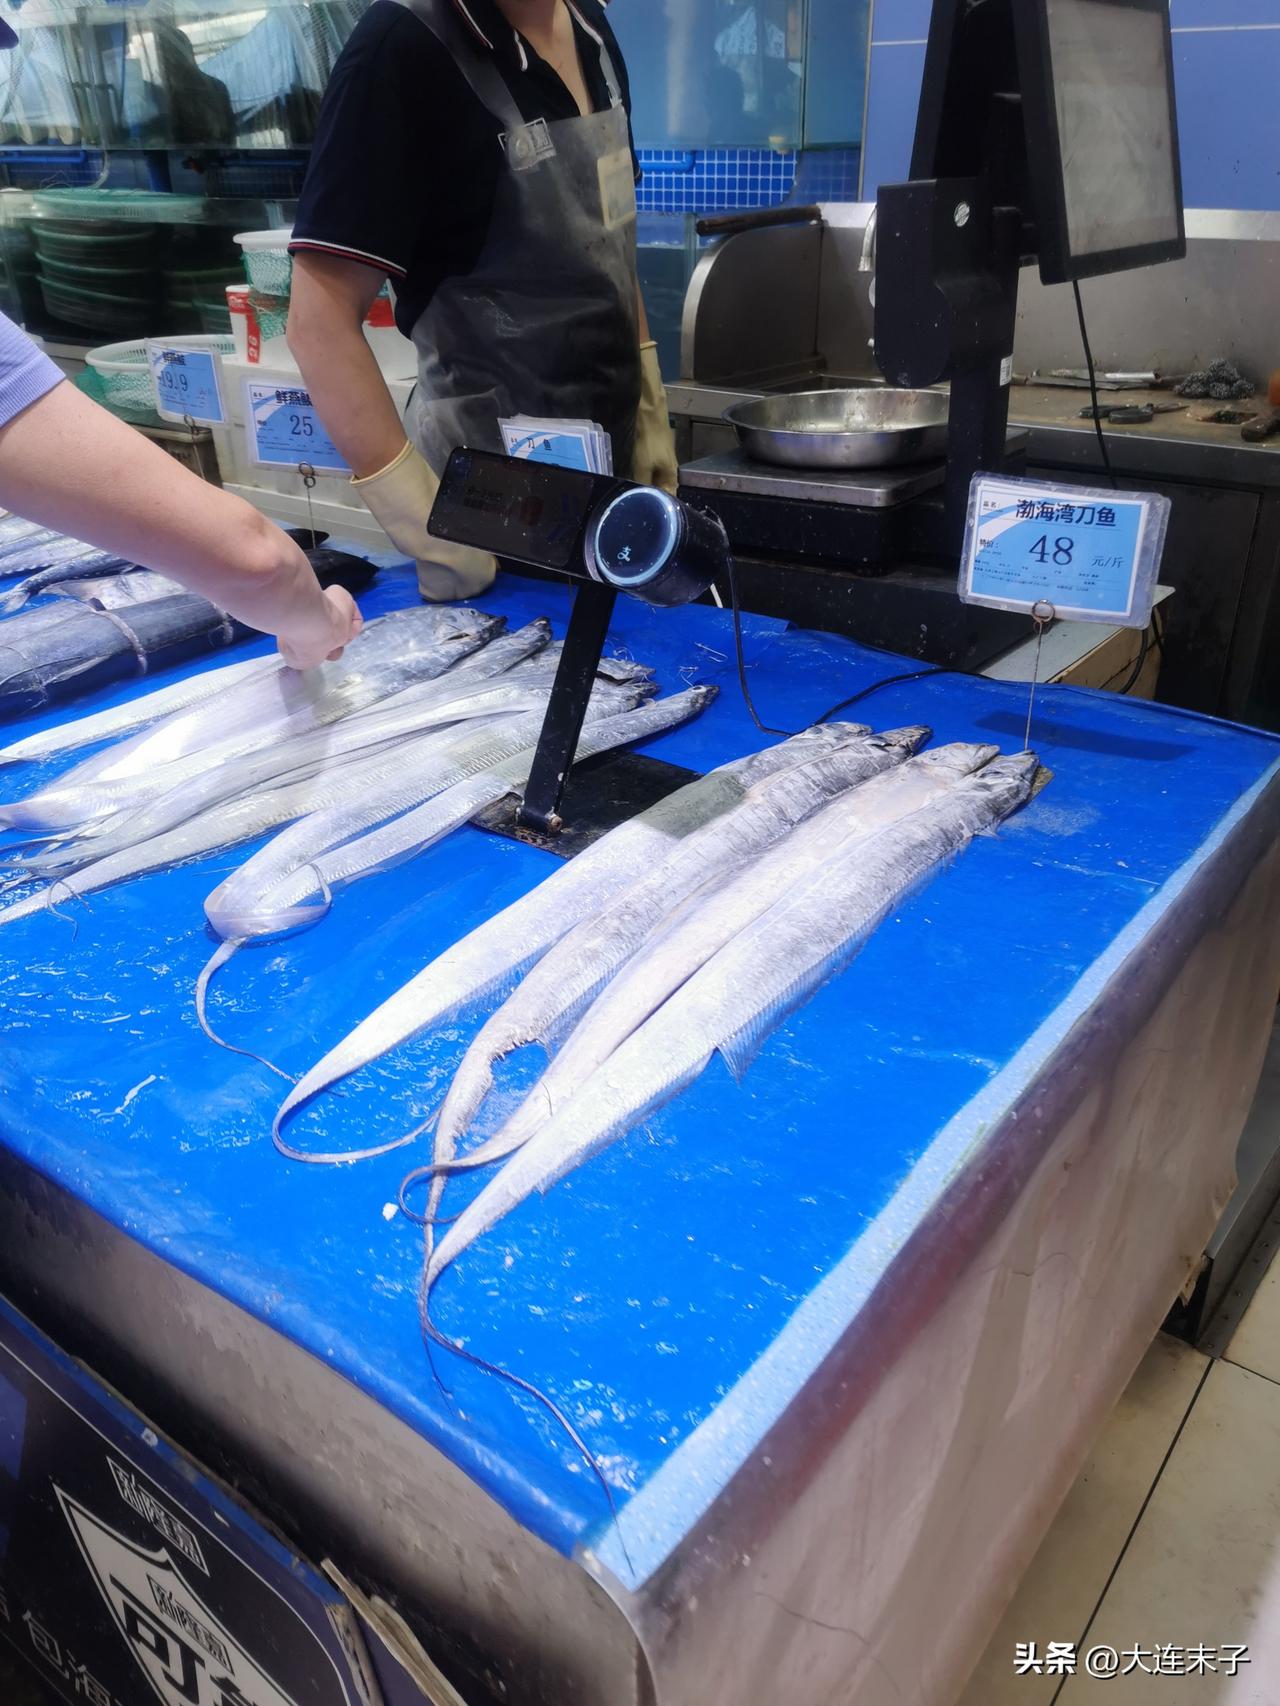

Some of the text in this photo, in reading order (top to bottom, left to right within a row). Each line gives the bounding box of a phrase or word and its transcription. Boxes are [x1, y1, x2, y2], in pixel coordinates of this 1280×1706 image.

[289, 414, 313, 437] 25
[1015, 498, 1117, 527] 渤海湾刀鱼
[1028, 534, 1075, 566] 48
[1091, 555, 1125, 569] 元/斤
